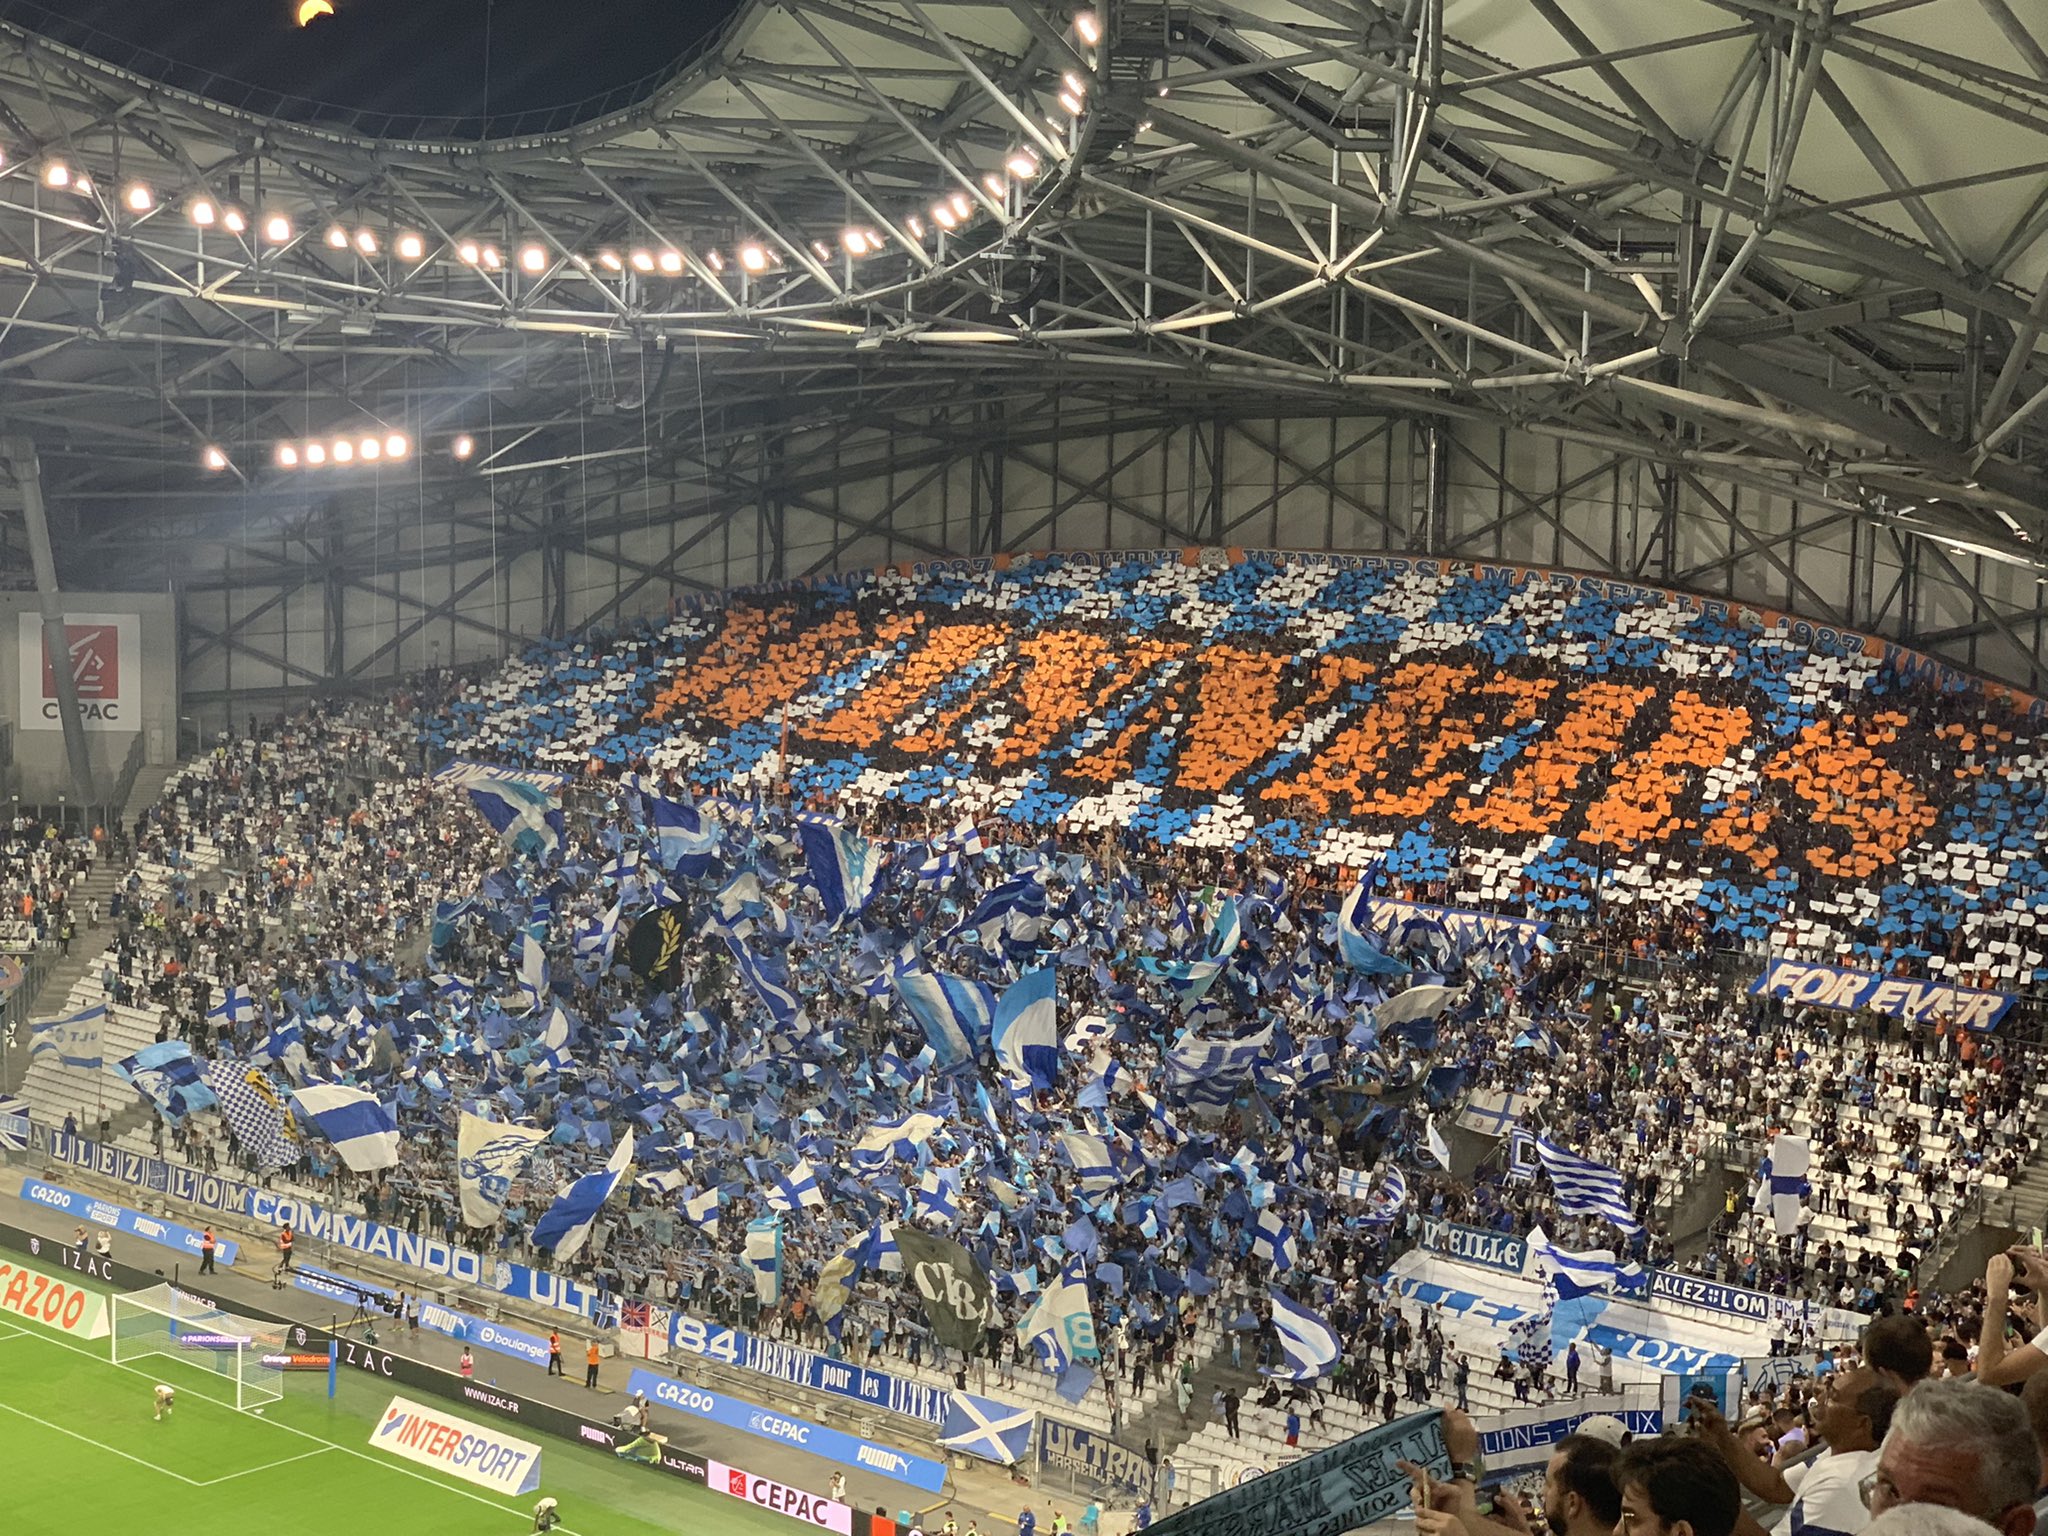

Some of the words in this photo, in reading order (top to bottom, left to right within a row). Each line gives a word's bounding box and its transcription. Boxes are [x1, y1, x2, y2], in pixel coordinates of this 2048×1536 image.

[42, 702, 119, 721] CPAC
[1757, 963, 1870, 1009] FOR
[1869, 980, 2004, 1029] EVER
[31, 1185, 71, 1208] CAZOO
[176, 1169, 247, 1213] L'OM
[252, 1189, 480, 1284] COMMANDO
[62, 1247, 113, 1280] IZAC
[1653, 1274, 1705, 1303] ALLEZ
[1721, 1290, 1766, 1317] L'OM
[263, 1354, 291, 1364] Orange
[292, 1354, 331, 1363] Vélodrom
[494, 1333, 550, 1359] boulanger
[674, 1315, 738, 1363] 84
[822, 1364, 852, 1390] pour
[860, 1369, 879, 1399] les
[889, 1377, 951, 1426] ULTRAS
[464, 1386, 519, 1414] WWW.IZAC.FR
[656, 1381, 714, 1412] CAZOO
[761, 1414, 810, 1444] CEPAC
[396, 1413, 527, 1482] INTERSPORT
[857, 1444, 897, 1472] PUMA
[664, 1455, 705, 1477] ULTRA
[752, 1479, 828, 1526] CEPAC
